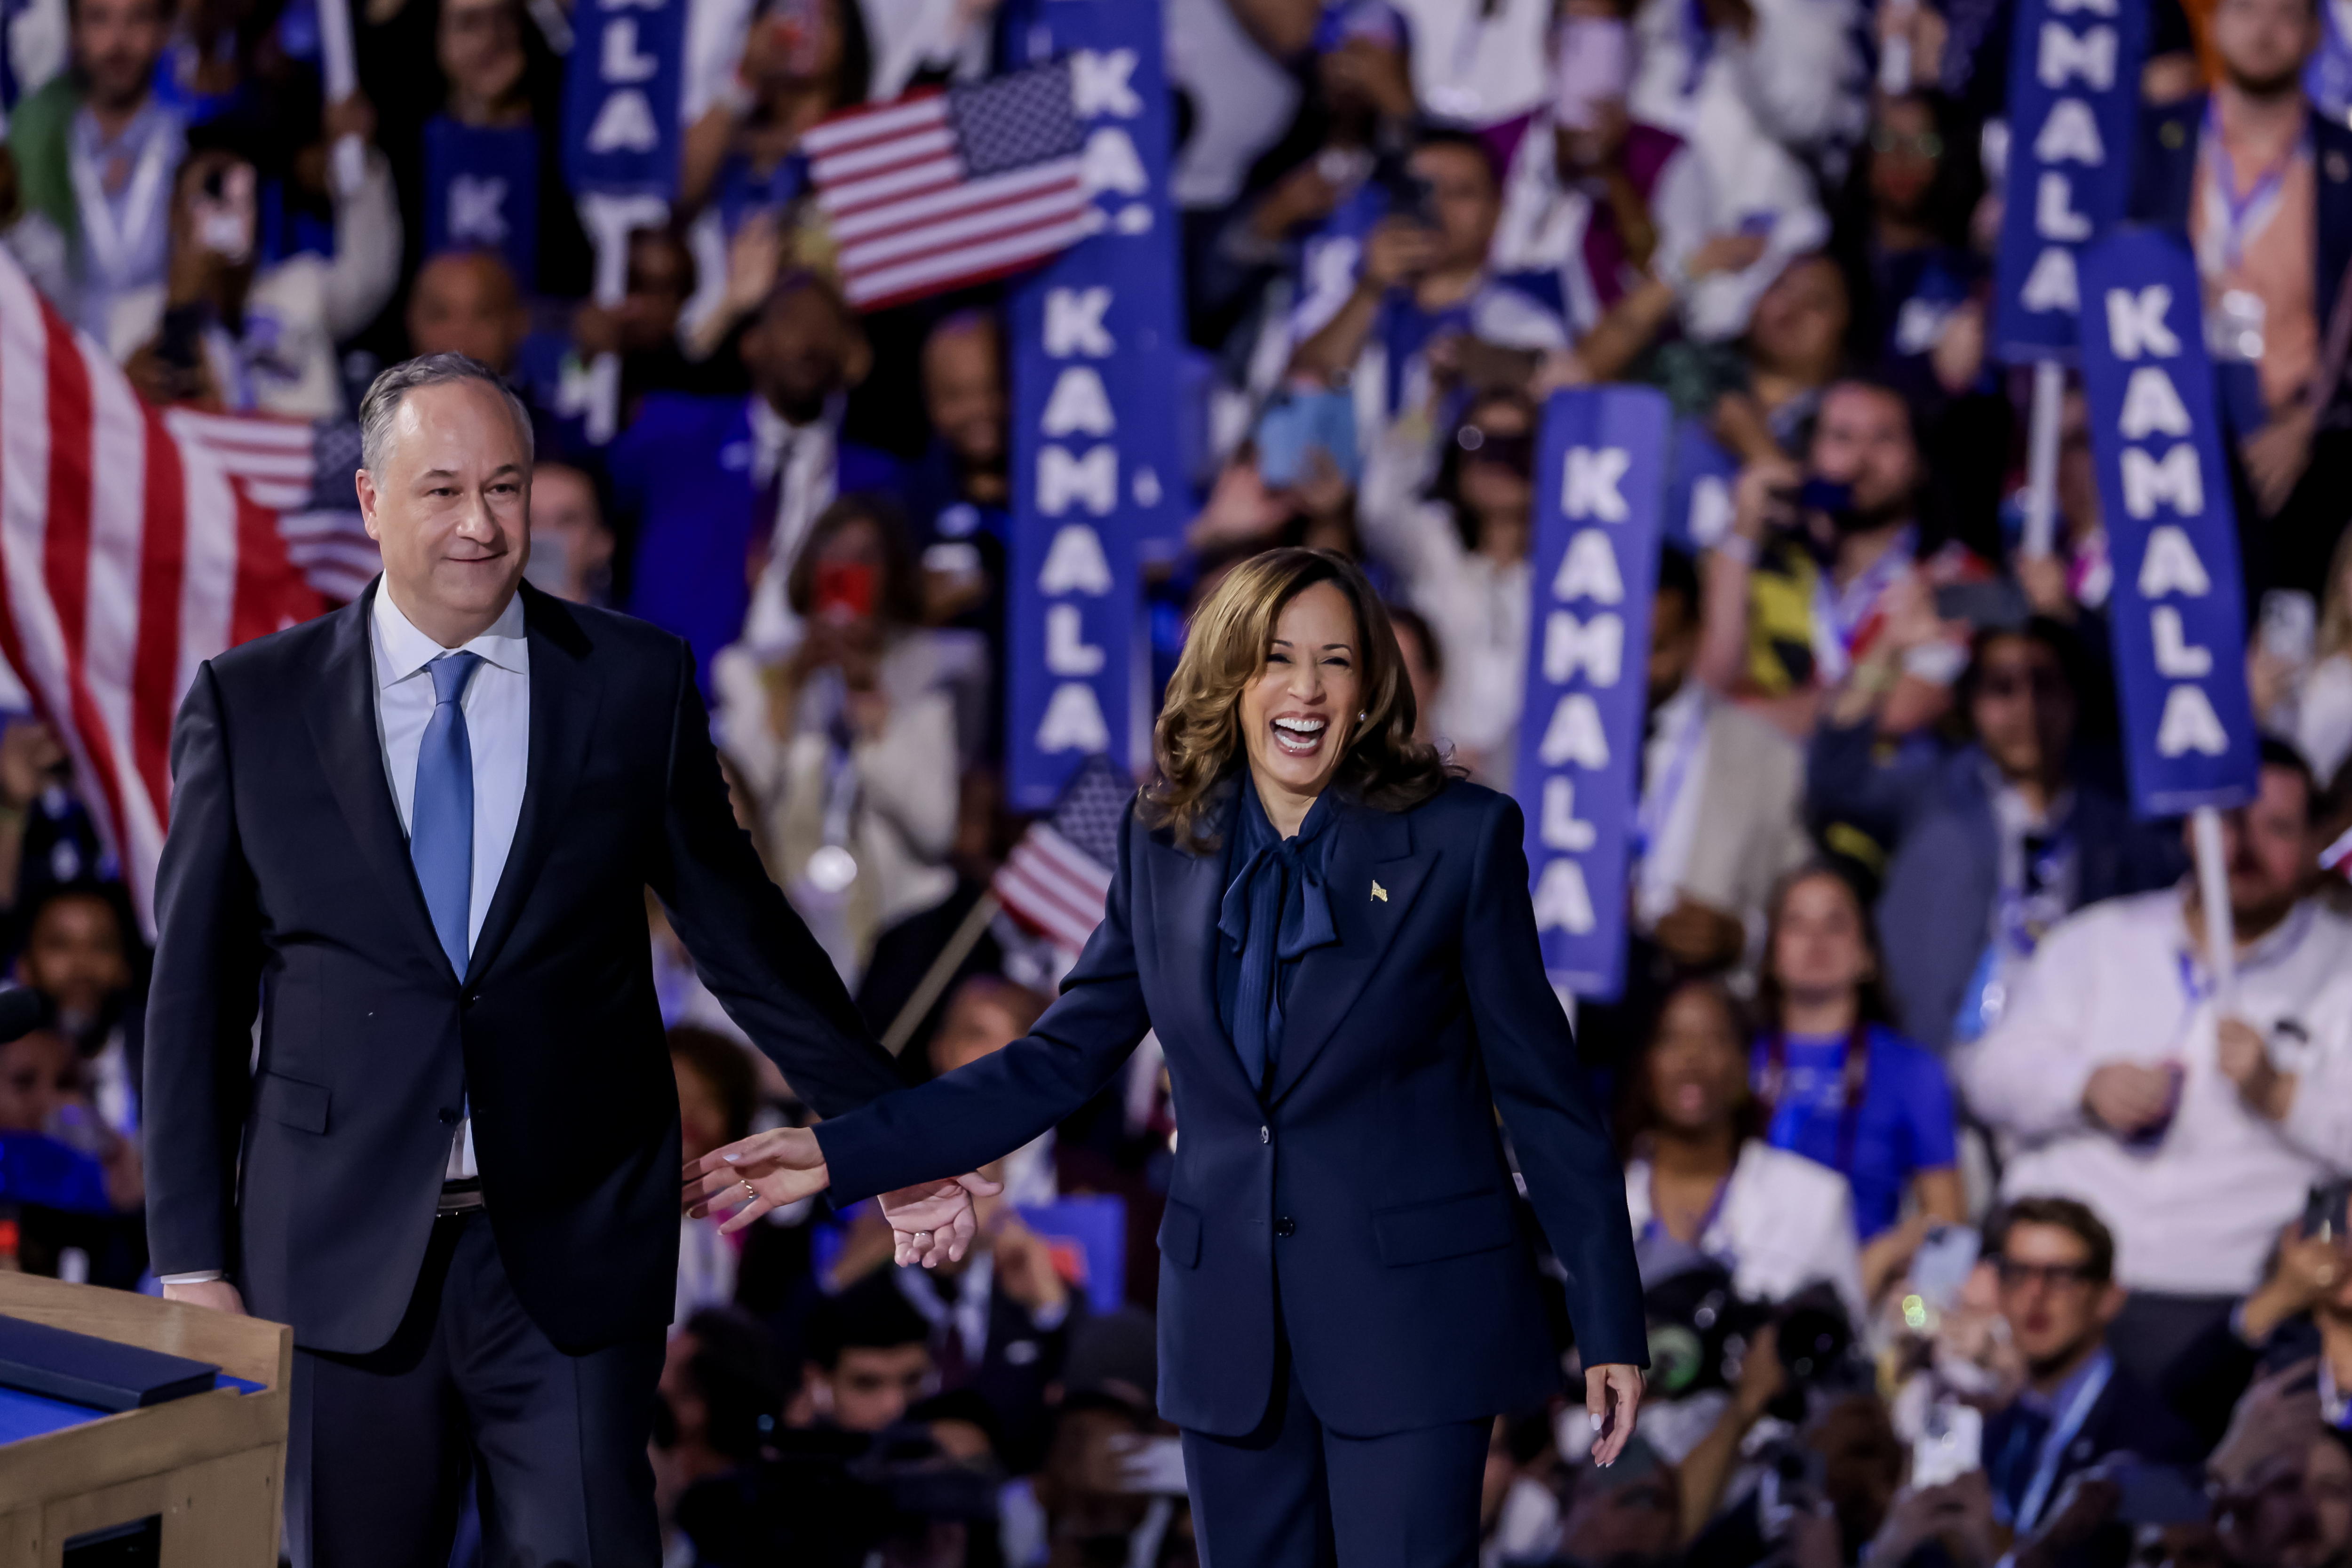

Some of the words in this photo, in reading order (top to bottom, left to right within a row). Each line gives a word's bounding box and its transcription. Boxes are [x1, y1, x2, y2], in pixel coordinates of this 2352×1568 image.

[593, 0, 659, 152] LA
[2022, 0, 2118, 313] MALA
[1037, 287, 1118, 754] KAMALA
[1532, 444, 1631, 937] KAMALA
[2104, 284, 2230, 757] KAMALA
